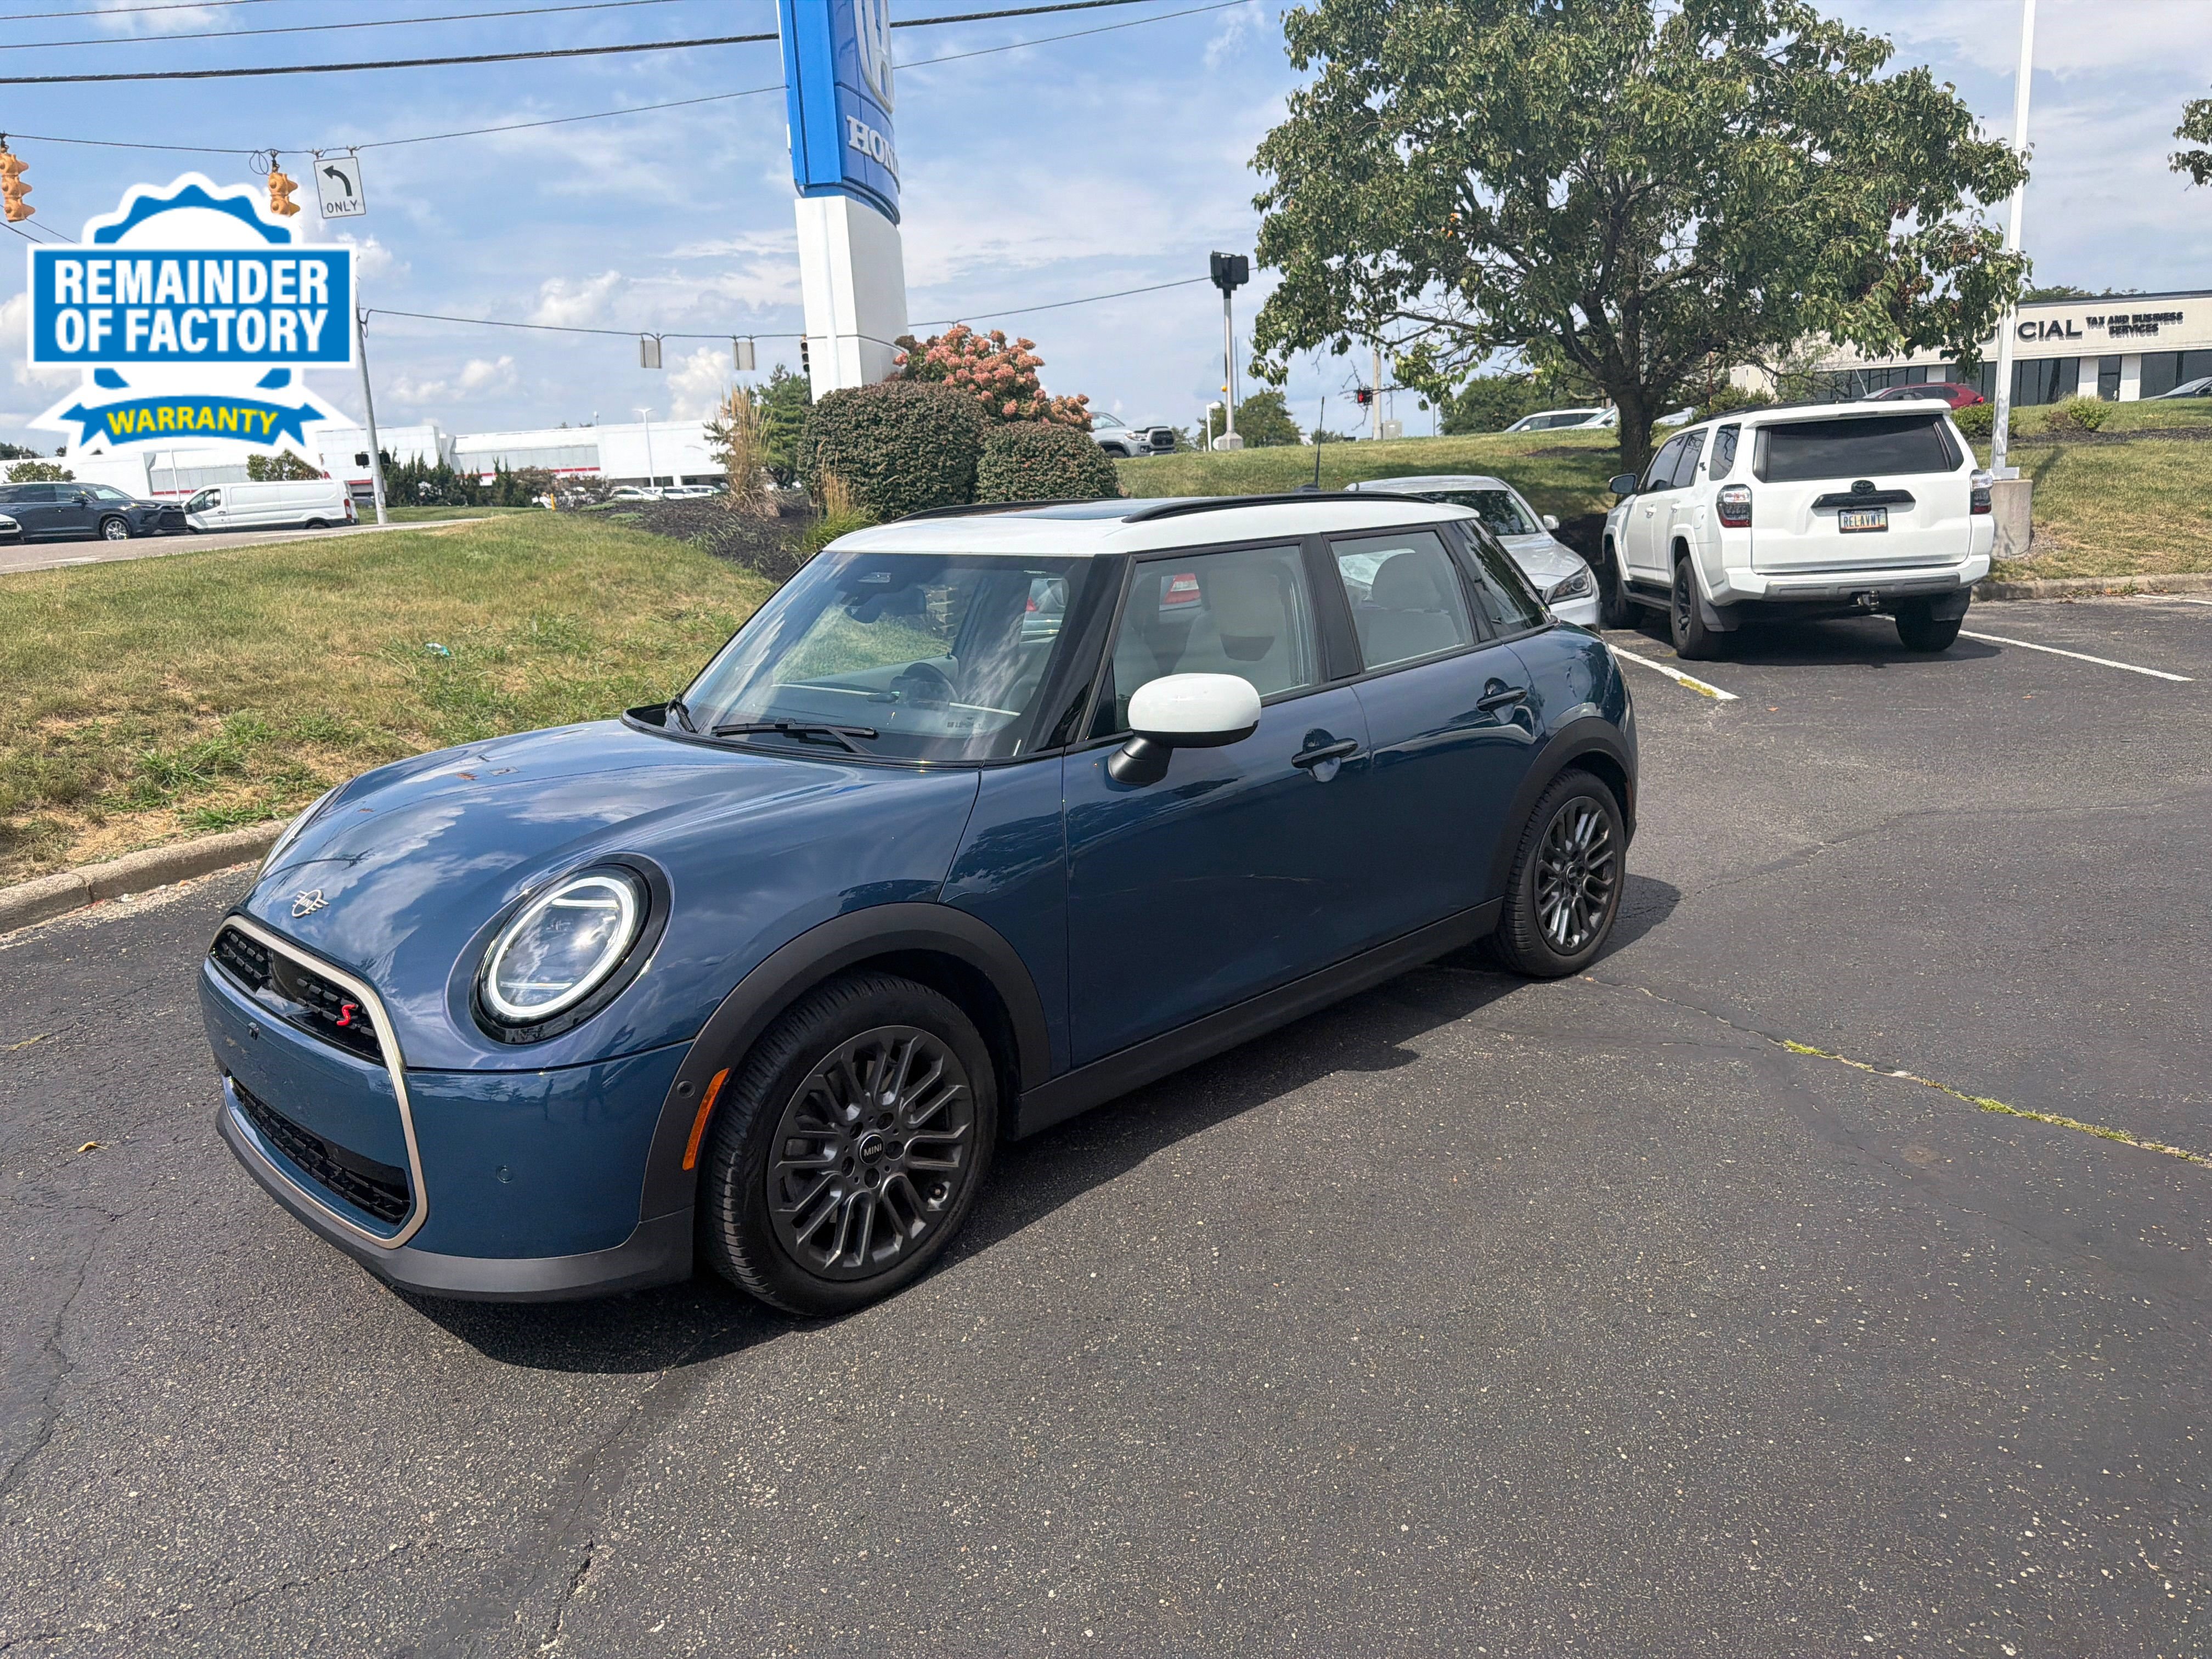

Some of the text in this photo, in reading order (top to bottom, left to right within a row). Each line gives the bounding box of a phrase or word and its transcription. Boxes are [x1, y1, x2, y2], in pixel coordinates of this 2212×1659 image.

[847, 115, 899, 176] HON
[326, 199, 358, 213] ONLY
[2085, 315, 2106, 328] TAX
[2108, 314, 2130, 325] AND
[2132, 311, 2183, 324] BUSINESS
[2108, 323, 2159, 336] SERVICES
[1843, 514, 1881, 528] RELAVNT
[864, 1143, 882, 1156] MINI
